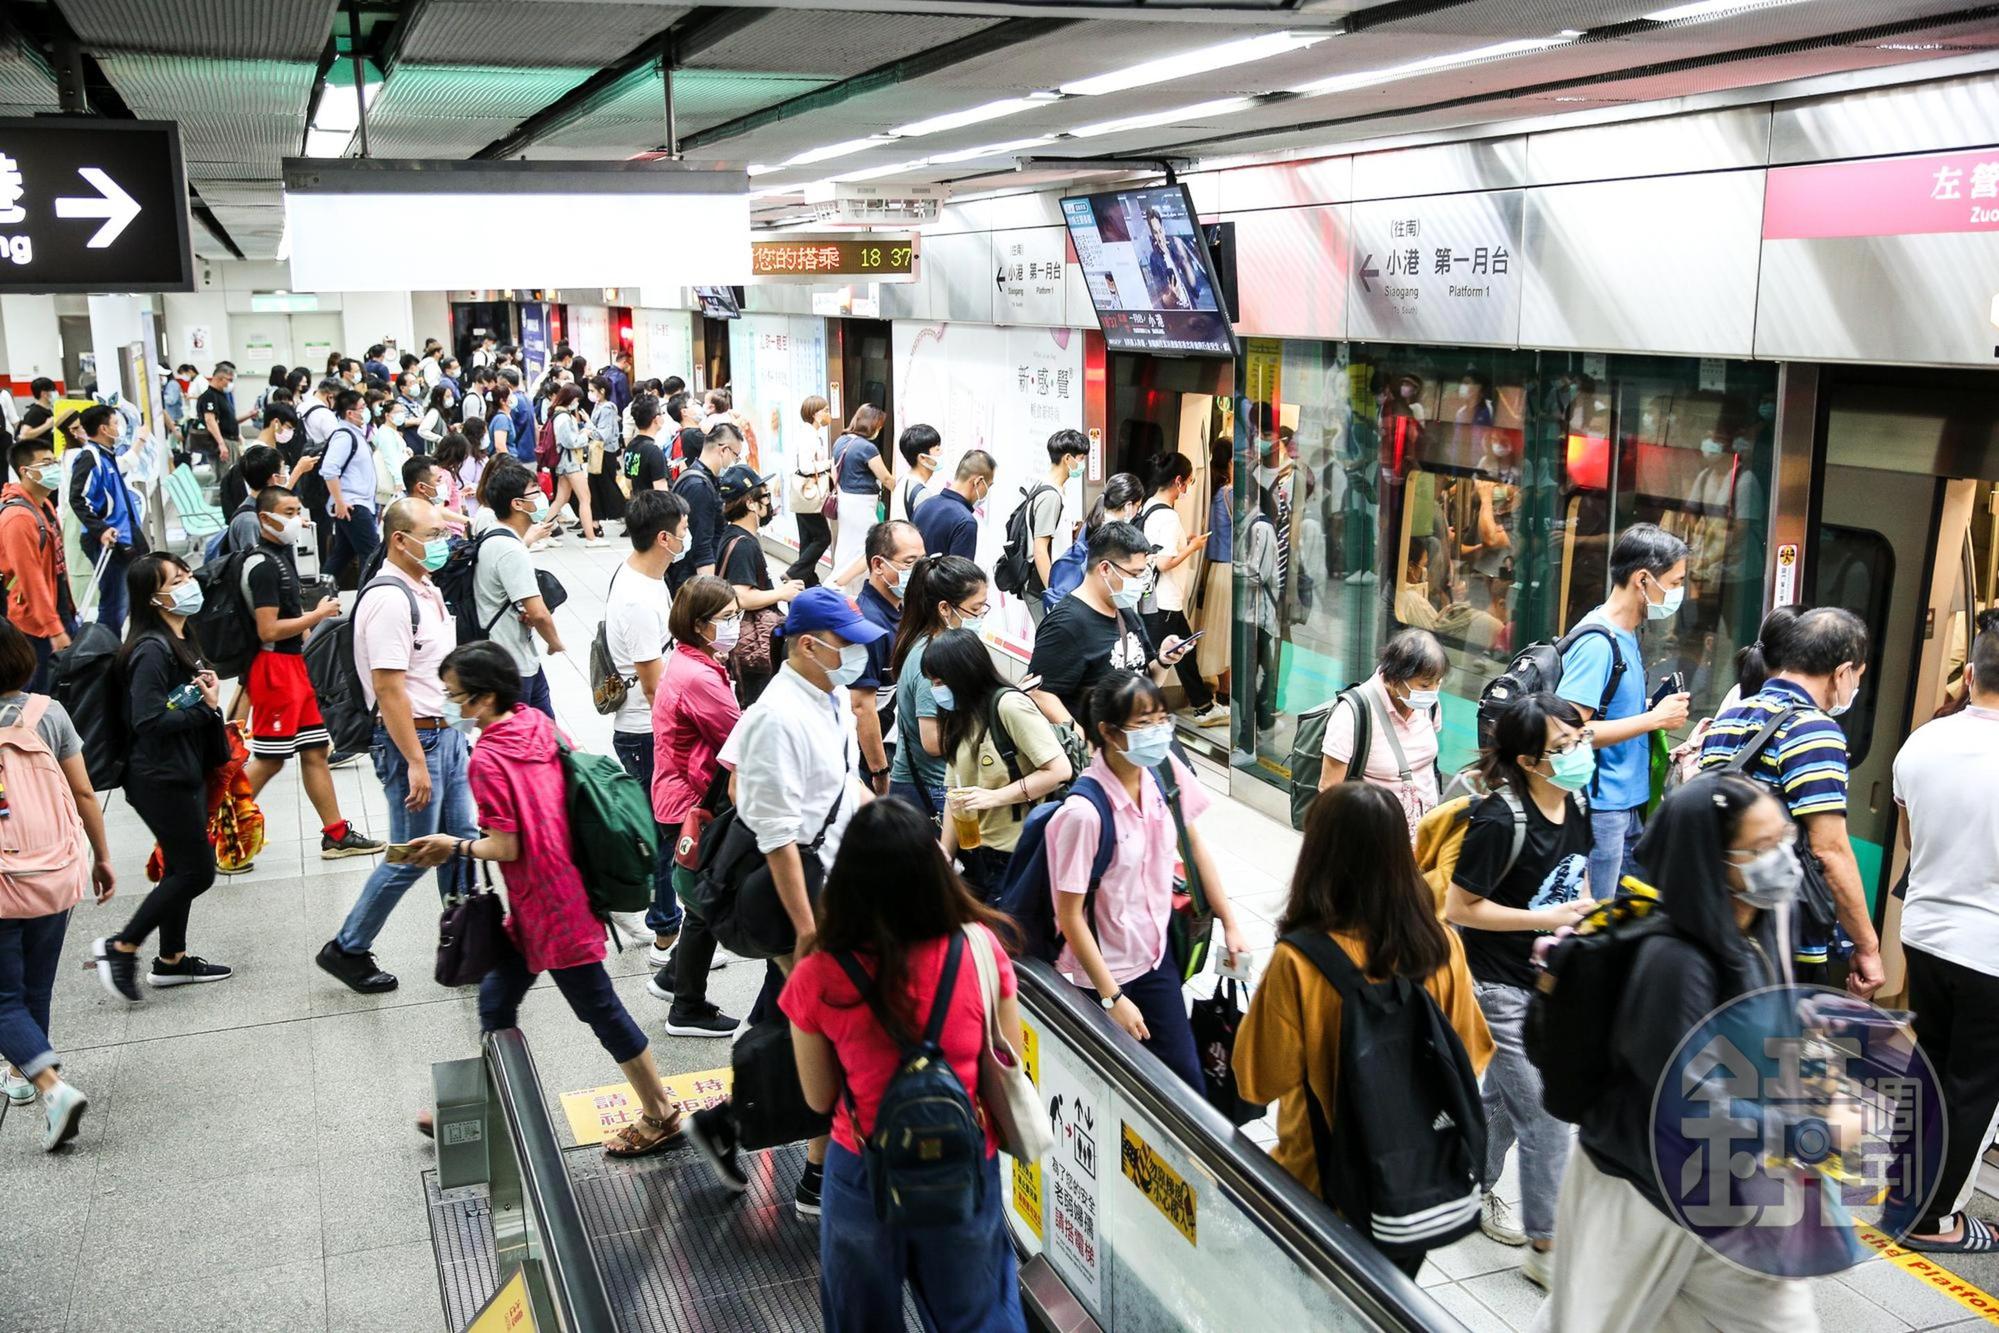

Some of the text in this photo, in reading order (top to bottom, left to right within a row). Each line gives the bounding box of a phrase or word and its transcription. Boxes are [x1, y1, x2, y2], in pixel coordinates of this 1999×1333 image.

[1391, 219, 1421, 239] (往南)
[752, 247, 840, 271] 您的搭乘
[1386, 246, 1510, 276] 小港 第一月台
[1008, 262, 1061, 281] 小港 第一月台
[1384, 285, 1419, 299] Siaogang
[1449, 286, 1483, 297] Platform
[1861, 1232, 1901, 1258] the
